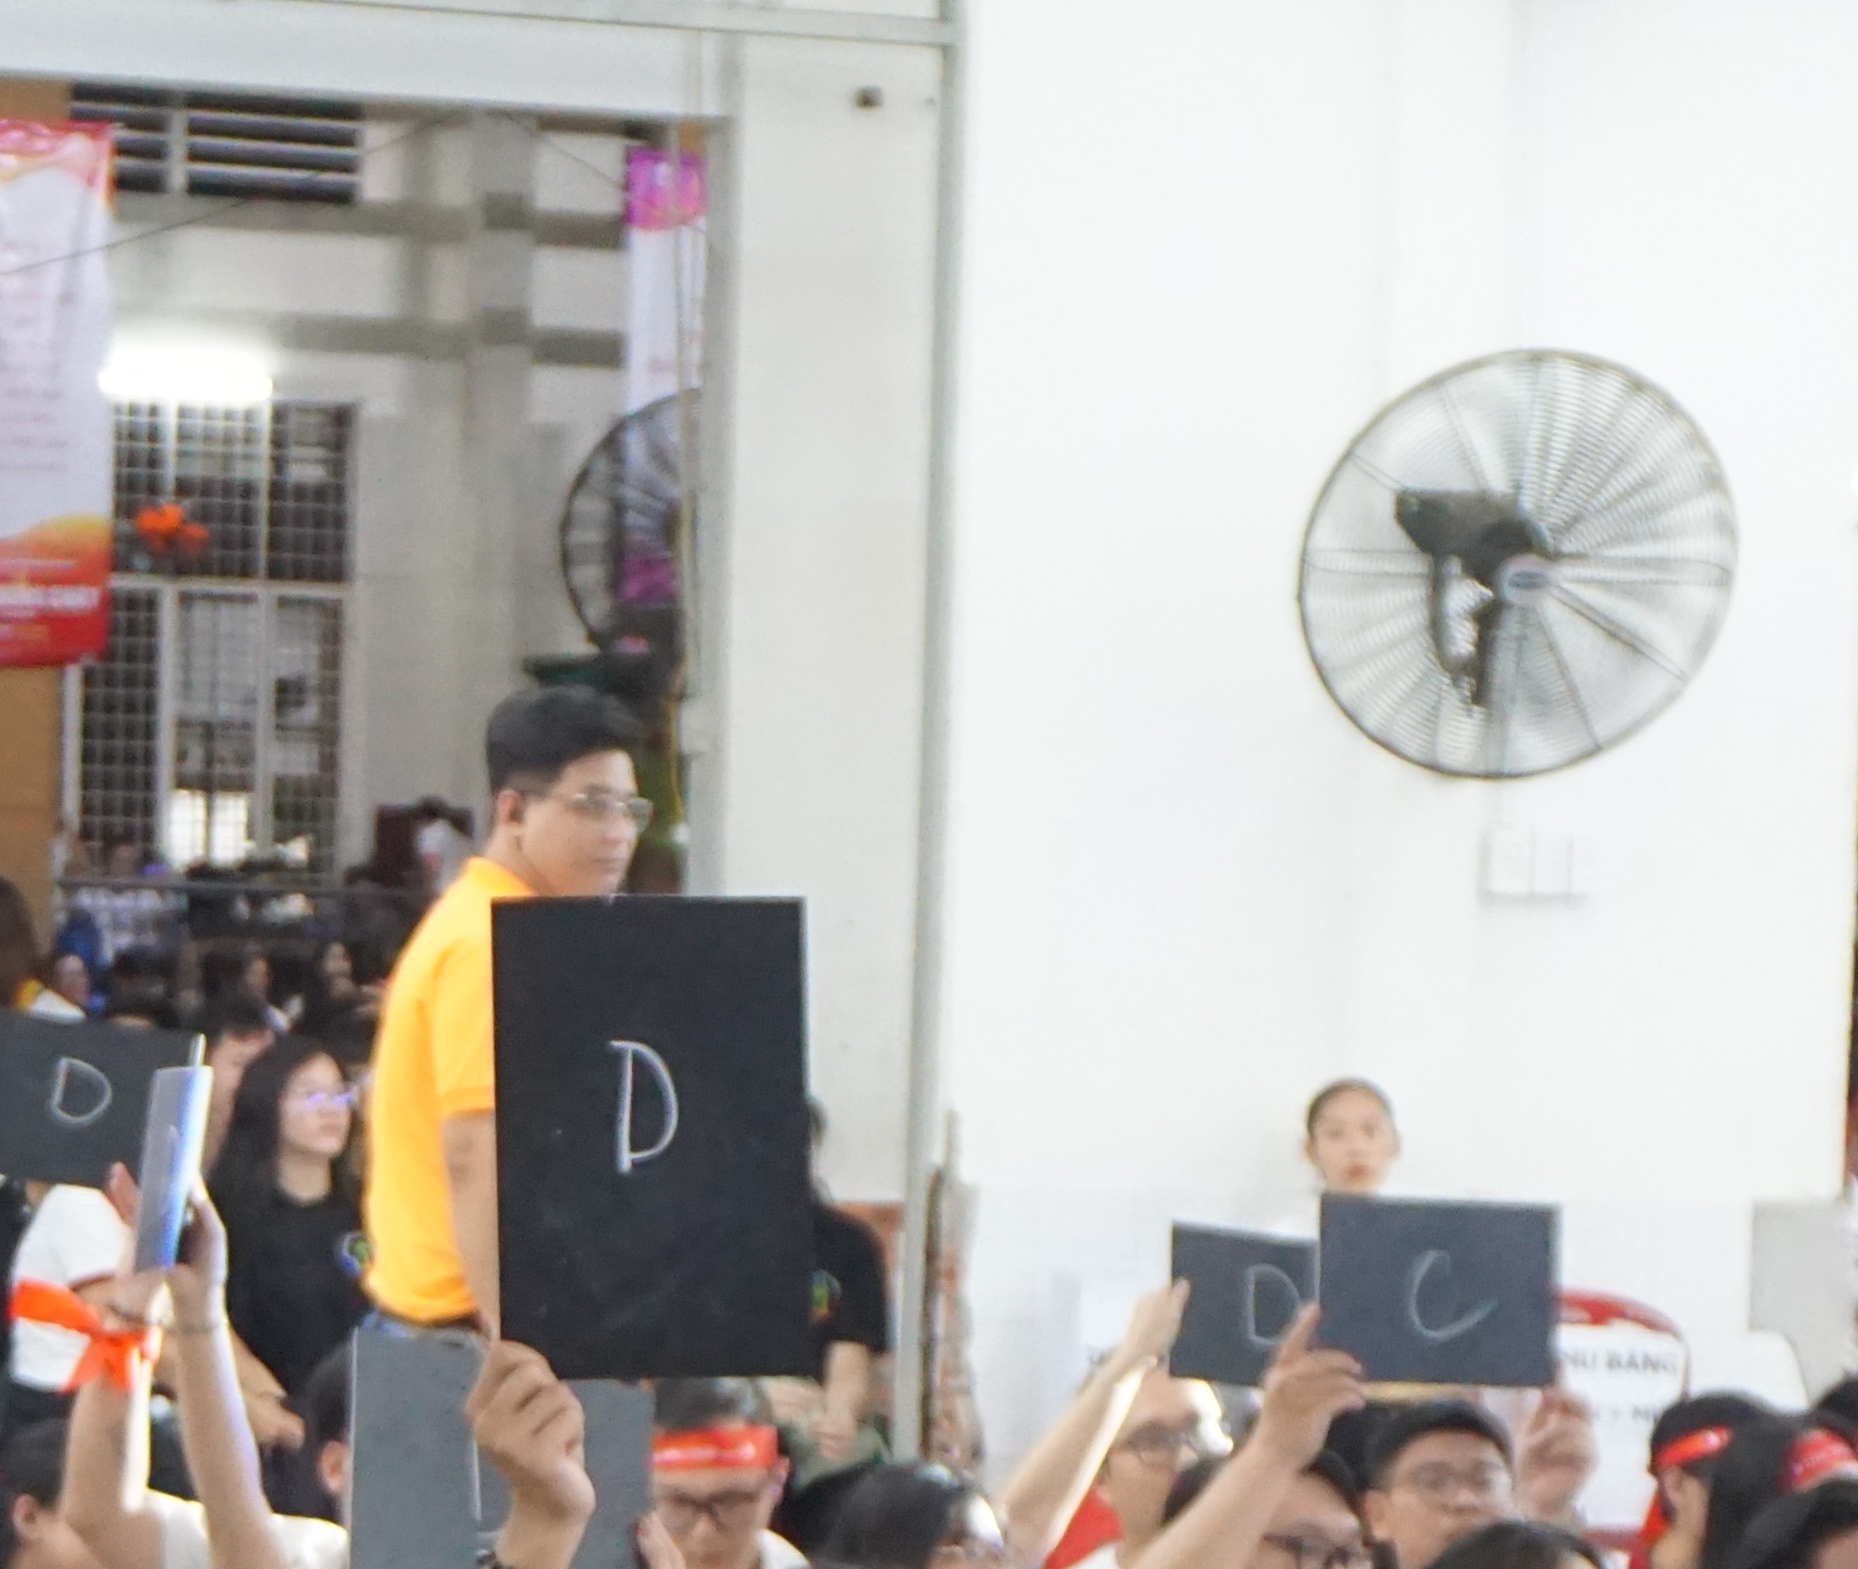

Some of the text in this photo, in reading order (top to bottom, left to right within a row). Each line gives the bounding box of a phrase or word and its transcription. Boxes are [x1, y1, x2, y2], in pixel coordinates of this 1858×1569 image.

[49, 1056, 112, 1126] D
[607, 1039, 680, 1174] D
[1243, 1263, 1302, 1349] D
[1408, 1249, 1499, 1342] C
